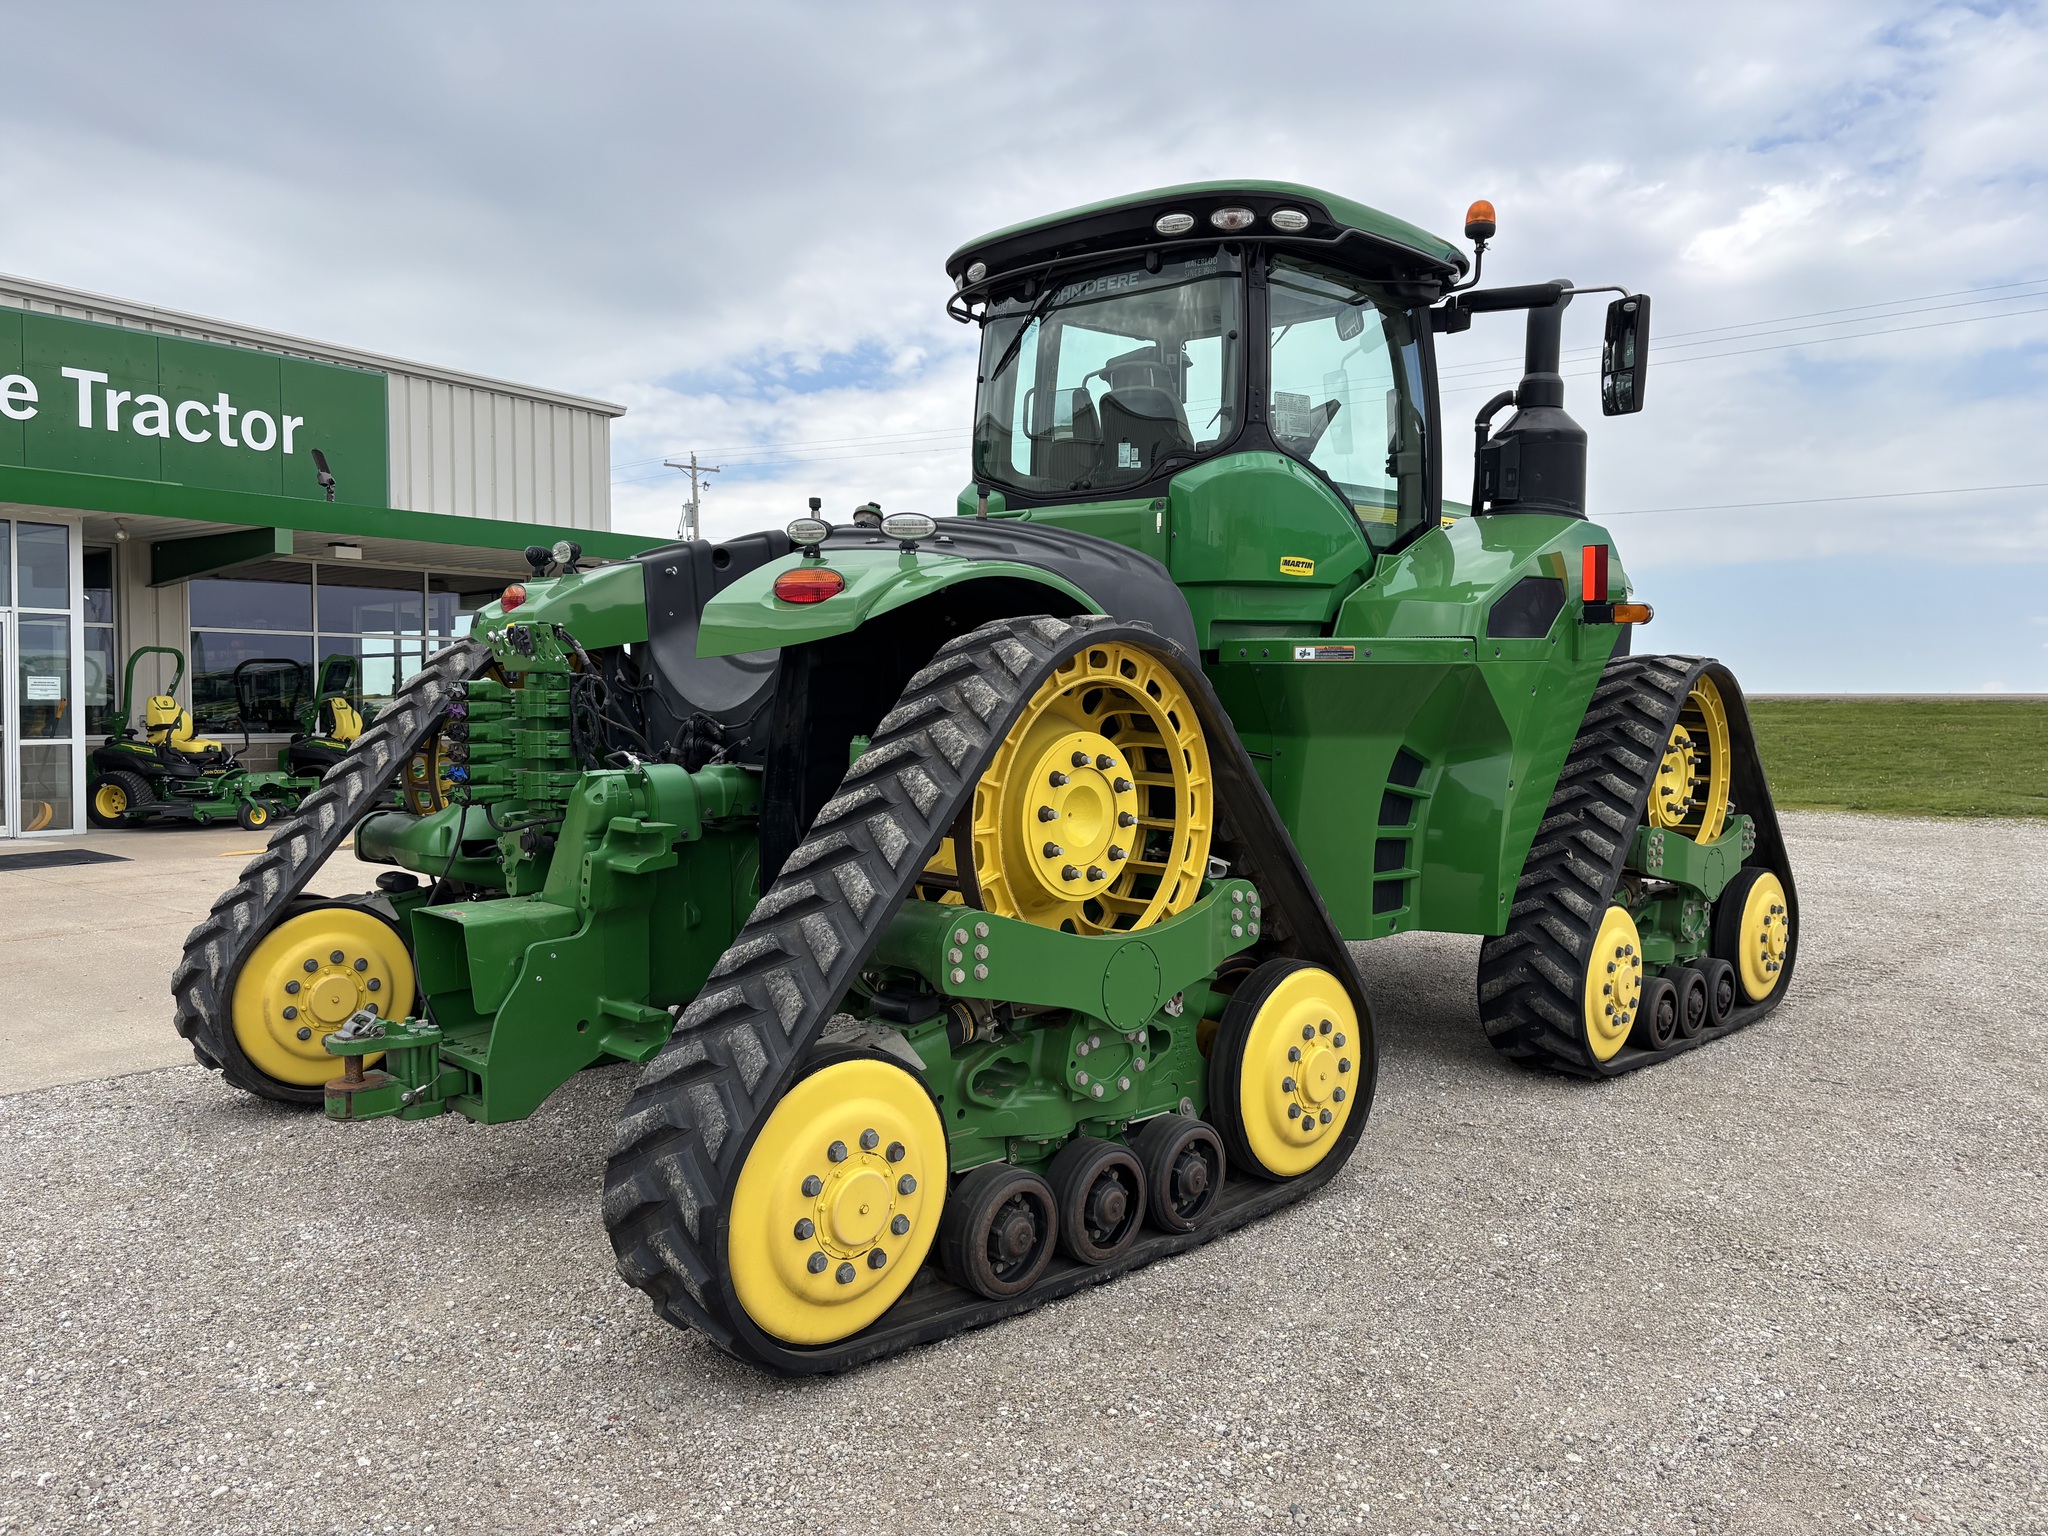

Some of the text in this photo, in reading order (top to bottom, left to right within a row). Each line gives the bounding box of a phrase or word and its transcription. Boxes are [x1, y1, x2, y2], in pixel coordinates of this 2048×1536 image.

[1184, 257, 1218, 268] WATERLOO
[1184, 267, 1202, 278] SINCE
[1084, 273, 1139, 295] DEERE
[61, 366, 304, 455] Tractor
[1283, 559, 1313, 569] MARTIN
